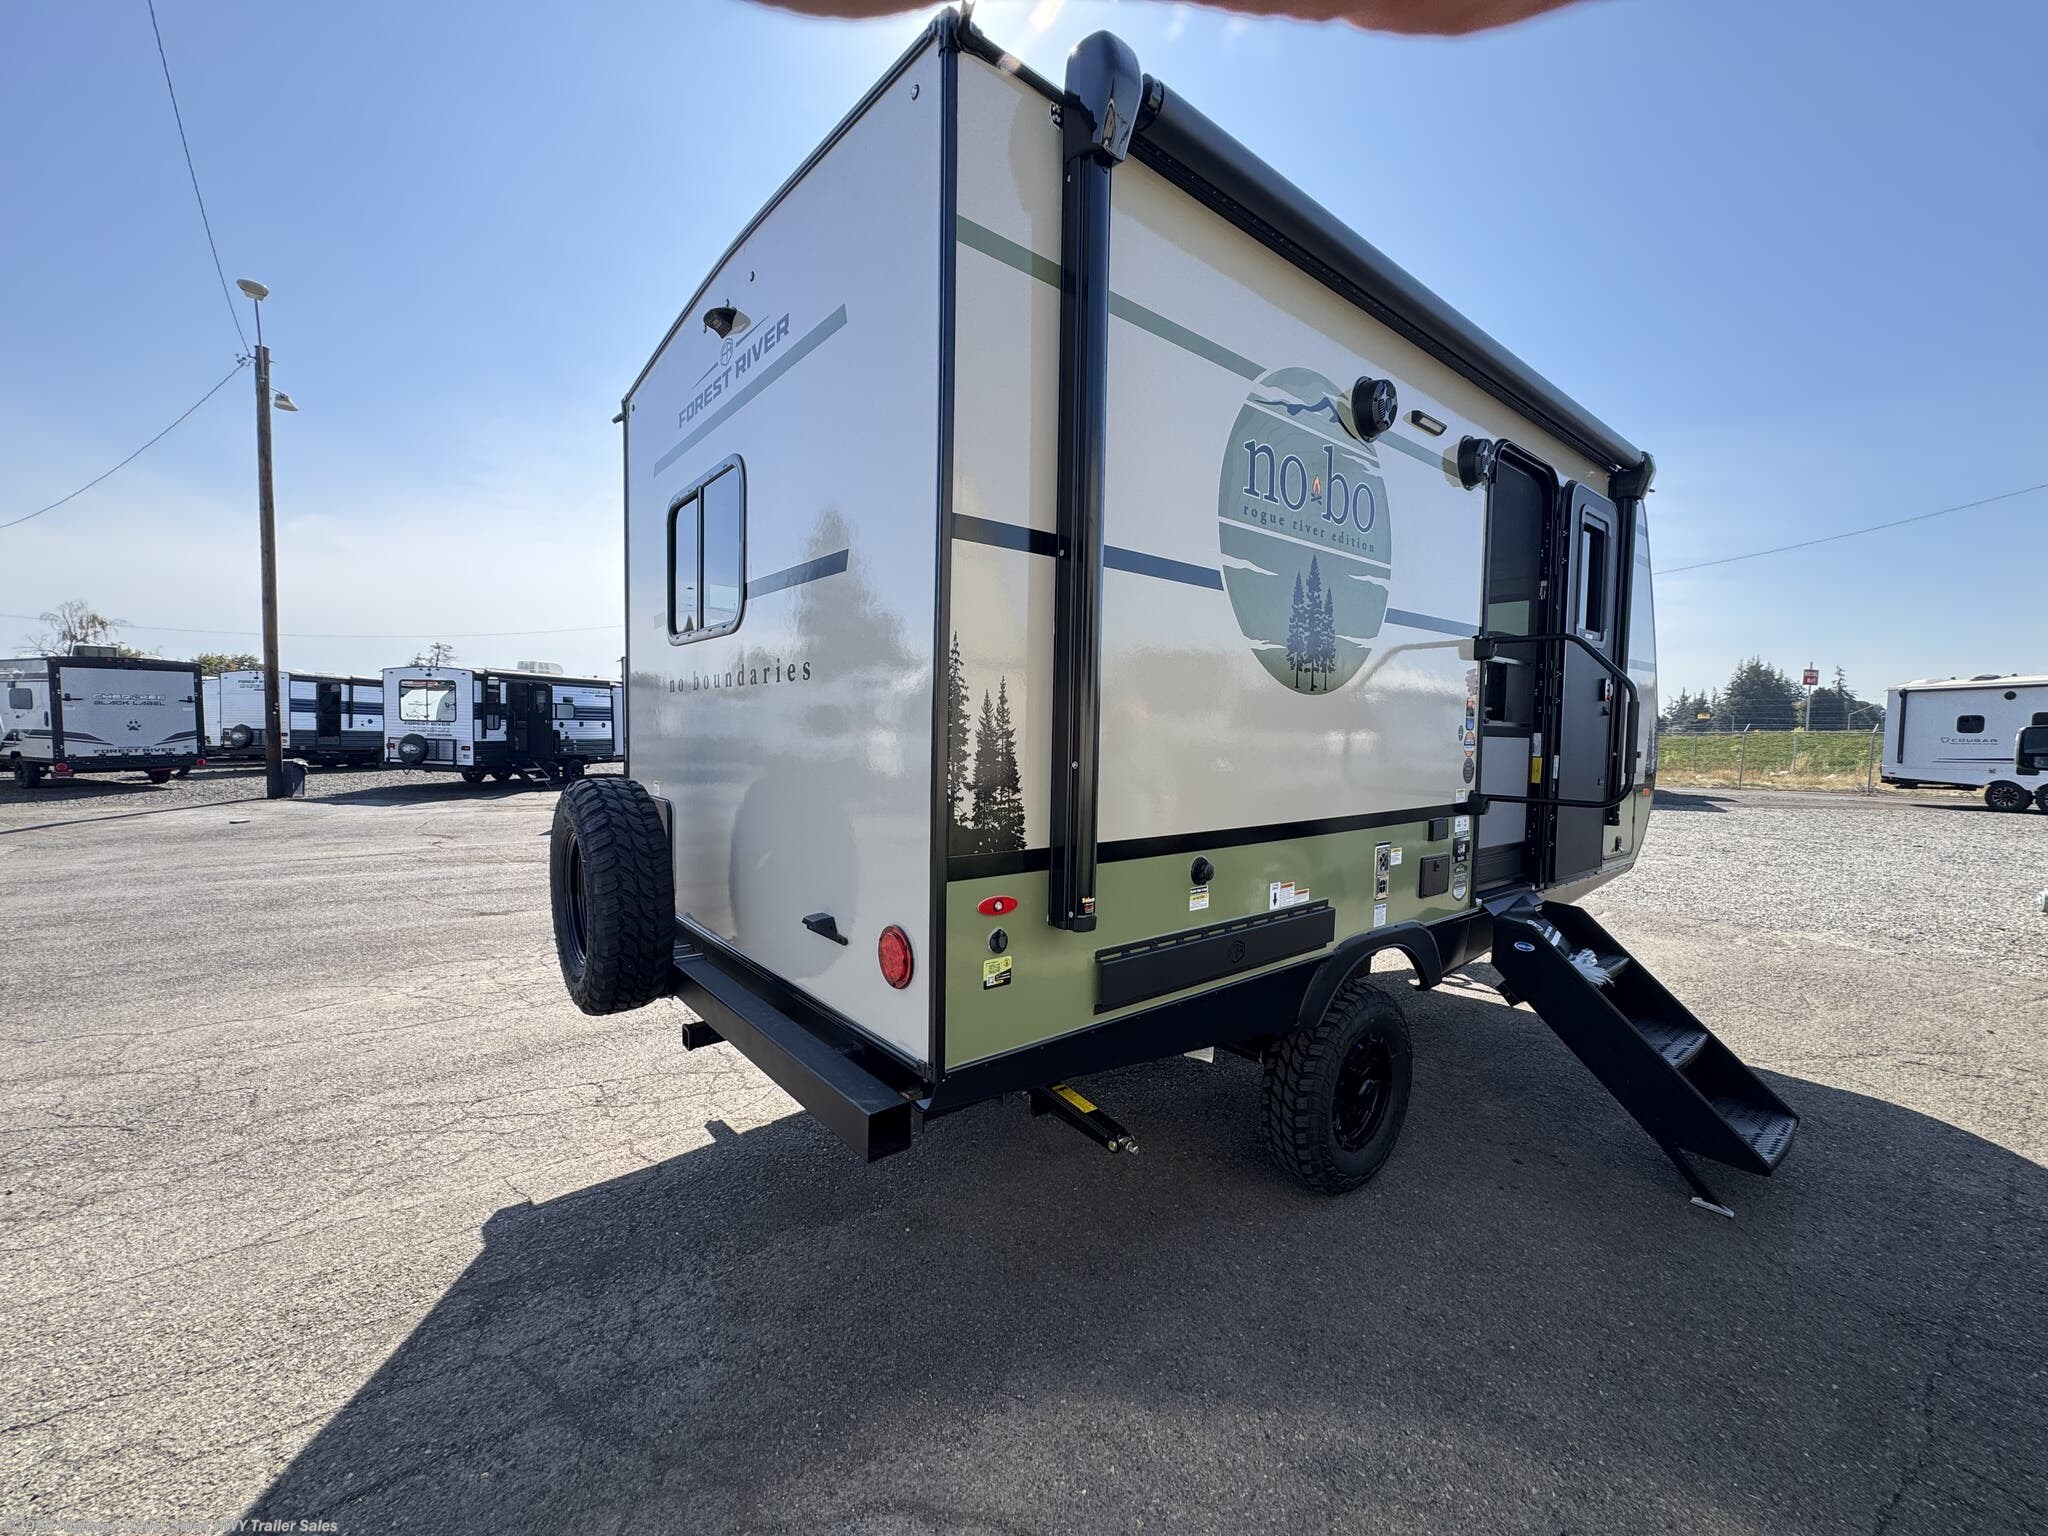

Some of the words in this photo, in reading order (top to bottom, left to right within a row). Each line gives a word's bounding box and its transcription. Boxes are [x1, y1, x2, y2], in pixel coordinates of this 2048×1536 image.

[678, 366, 732, 429] FOREST
[735, 313, 790, 379] RIVER
[1243, 504, 1285, 525] rogue
[1292, 519, 1326, 538] river
[1331, 531, 1376, 553] edition
[669, 678, 684, 693] no
[693, 657, 811, 691] boundaries
